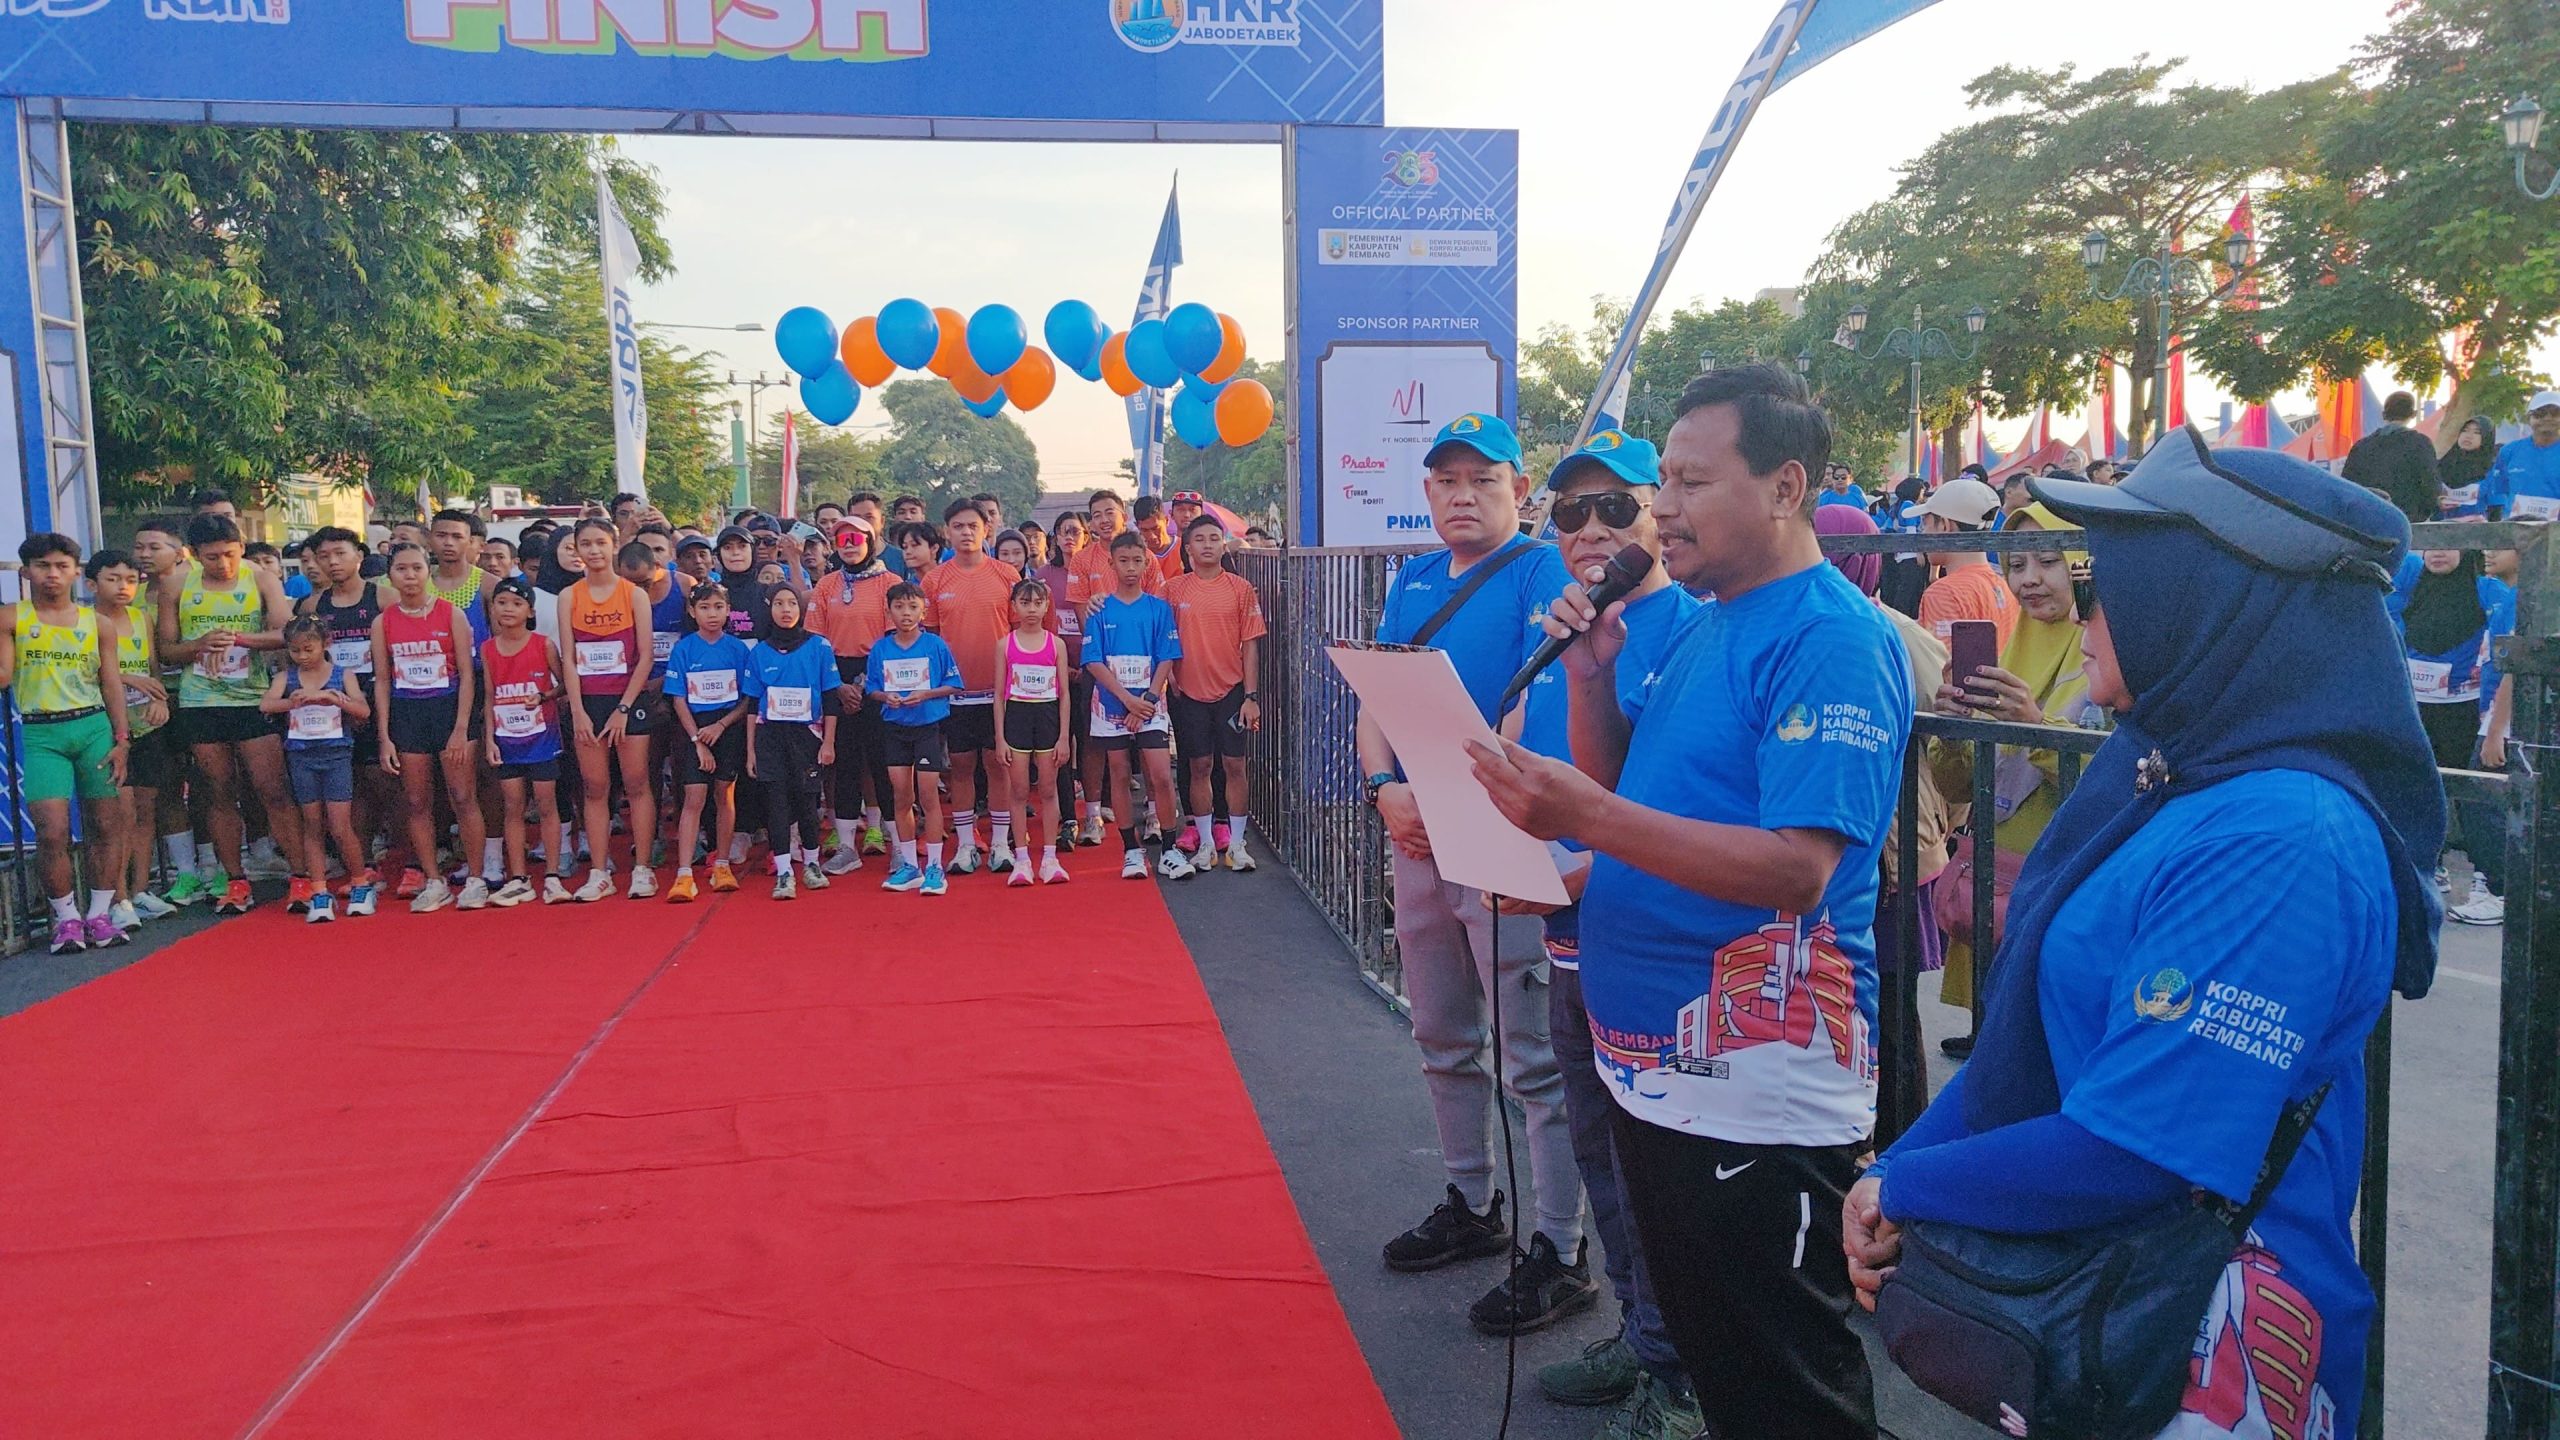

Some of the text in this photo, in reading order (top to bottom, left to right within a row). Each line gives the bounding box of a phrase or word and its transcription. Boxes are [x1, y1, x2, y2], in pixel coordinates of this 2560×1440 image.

[1185, 27, 1296, 41] JABODETABEK
[1382, 150, 1439, 187] 285
[1332, 205, 1495, 221] OFFICIAL PARTNER
[1349, 235, 1402, 243] PEMERINTAH
[1349, 243, 1399, 251] KABUPATEN
[1349, 252, 1391, 260] REMBANG
[1338, 318, 1479, 329] SPONSOR PARTNER
[1340, 454, 1386, 469] Pralon
[1386, 515, 1432, 529] PNM
[190, 614, 251, 624] REMBANG
[391, 640, 443, 657] BIMA
[26, 650, 88, 663] REMBANG
[119, 660, 149, 669] BANG
[408, 667, 433, 676] 10741
[2412, 673, 2435, 683] 13377
[1823, 703, 1871, 721] KORPRI
[1823, 718, 1890, 745] KABUPATEN
[1822, 730, 1879, 753] REMBANG
[2205, 980, 2288, 1023] KORPRI
[1608, 1029, 1676, 1049] REMBAN
[2187, 1018, 2293, 1070] REMBANG
